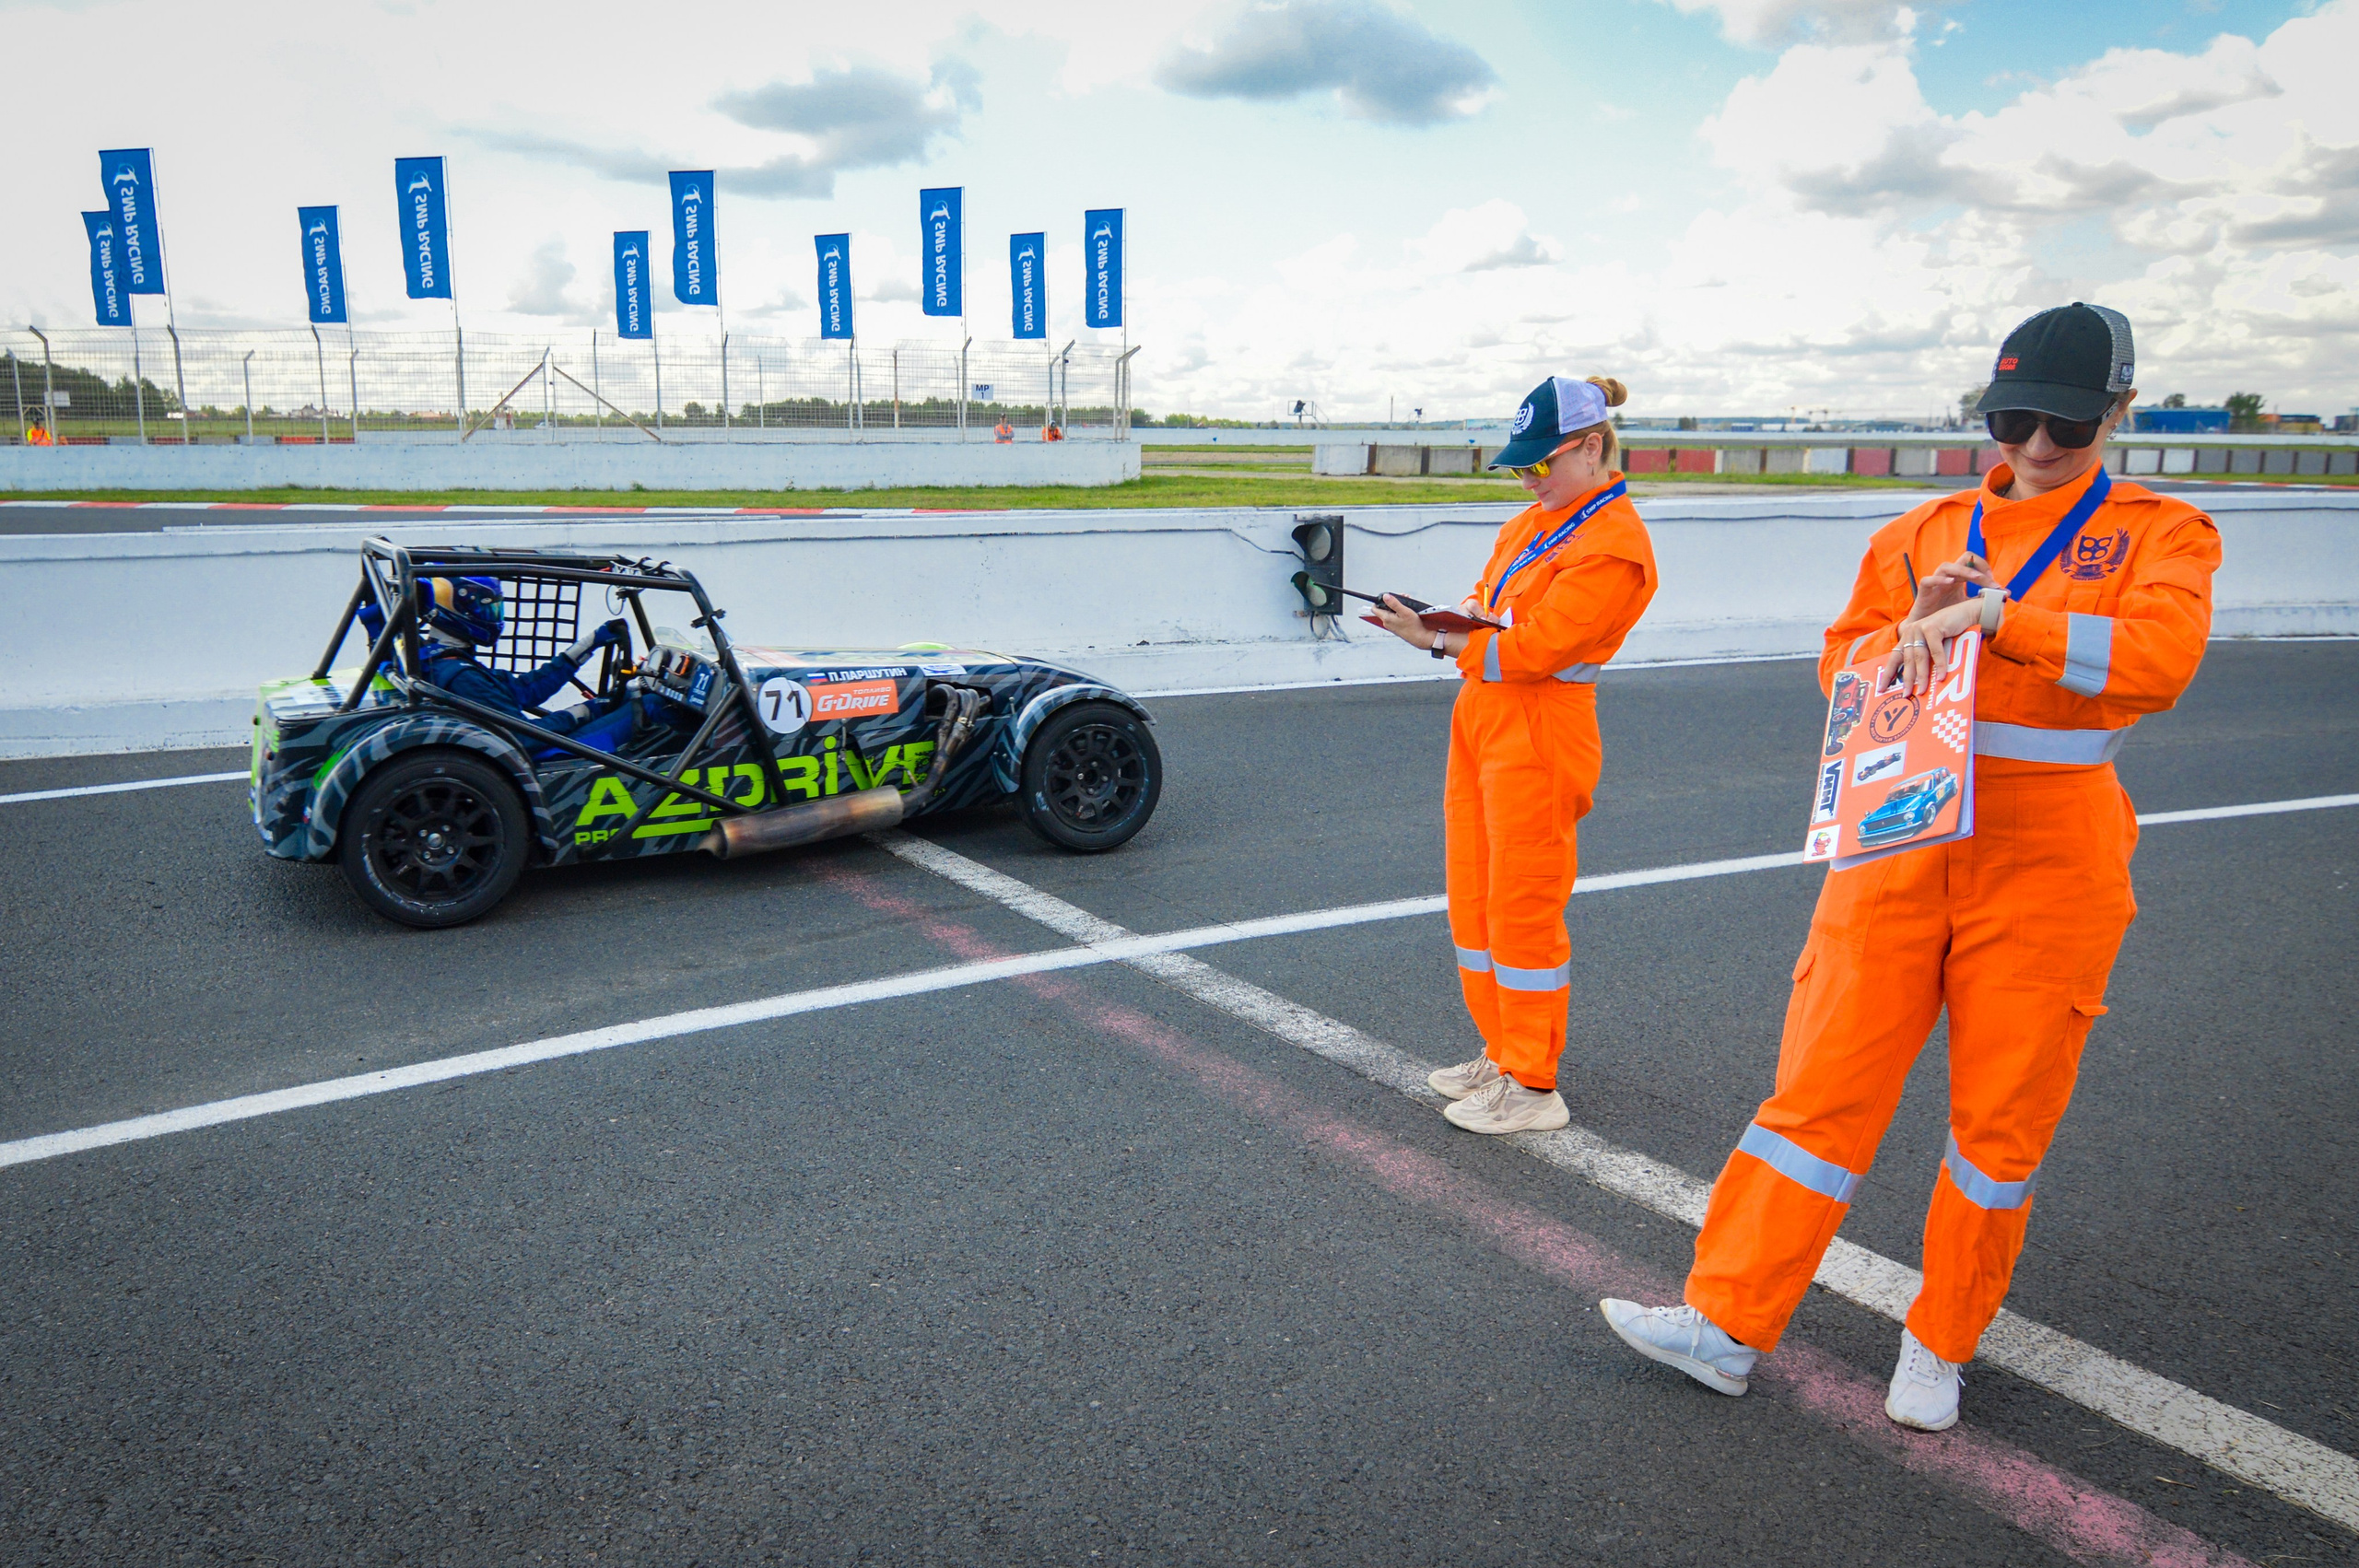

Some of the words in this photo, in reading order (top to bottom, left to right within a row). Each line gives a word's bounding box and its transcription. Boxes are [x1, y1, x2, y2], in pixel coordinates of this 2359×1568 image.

[1585, 504, 1597, 514] SMP
[1596, 493, 1614, 507] RACING
[1547, 535, 1558, 544] SMP
[1558, 521, 1576, 538] RACING
[696, 673, 710, 690] 71
[827, 668, 908, 683] П.ПАРШУТИН
[765, 690, 802, 721] 71
